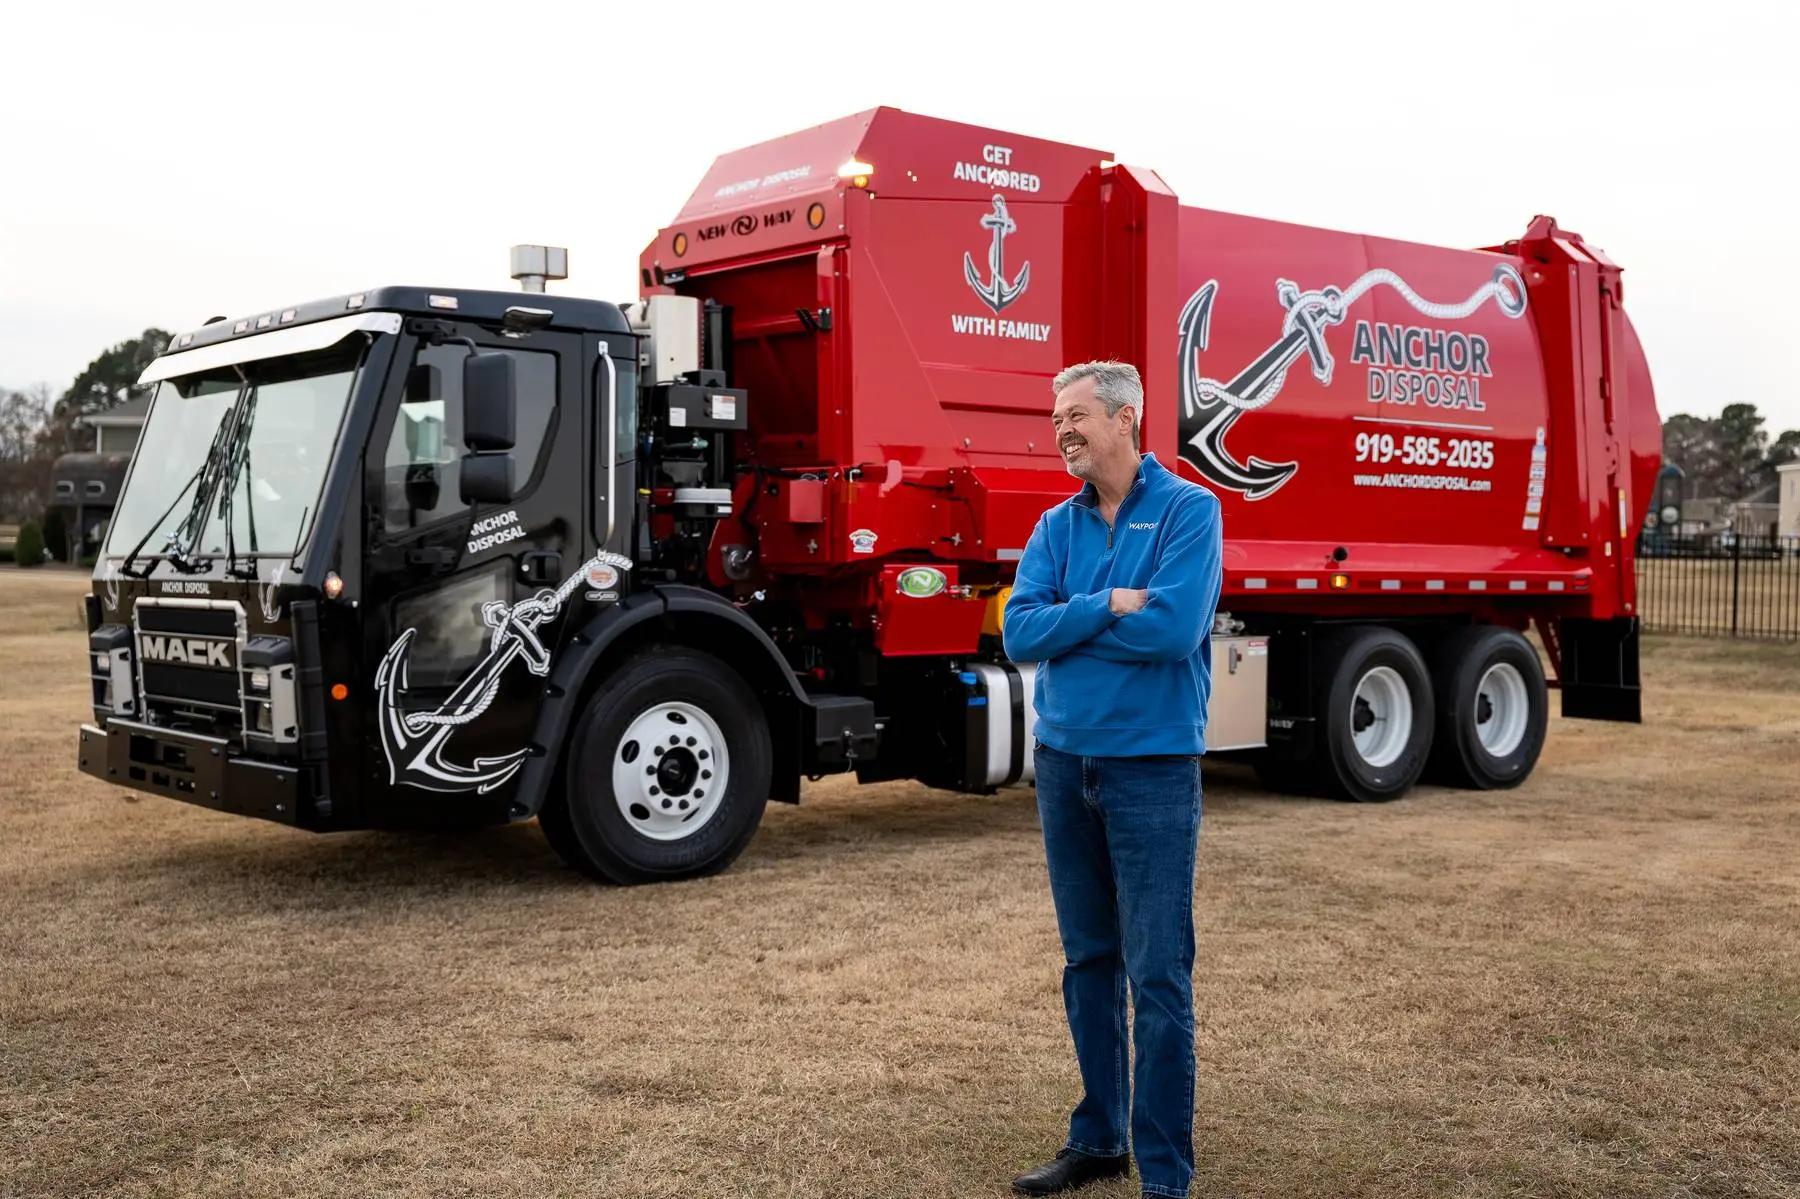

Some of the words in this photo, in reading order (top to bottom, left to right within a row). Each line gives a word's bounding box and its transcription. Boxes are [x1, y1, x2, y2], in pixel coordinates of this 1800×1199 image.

[983, 144, 1012, 166] GET
[696, 223, 729, 242] NEW
[763, 208, 796, 228] WAY
[952, 314, 995, 336] WITH
[998, 319, 1051, 342] FAMILY
[1350, 319, 1493, 378] ANCHOR
[1368, 367, 1486, 412] DISPOSAL
[1355, 432, 1495, 469] 919-585-2035
[1353, 473, 1492, 492] www.ANCHORDISPOSAL.com
[467, 525, 527, 554] DISPOSAL
[161, 581, 183, 594] ANCHOR
[184, 582, 211, 595] DISPOSAL
[142, 636, 231, 667] MACK
